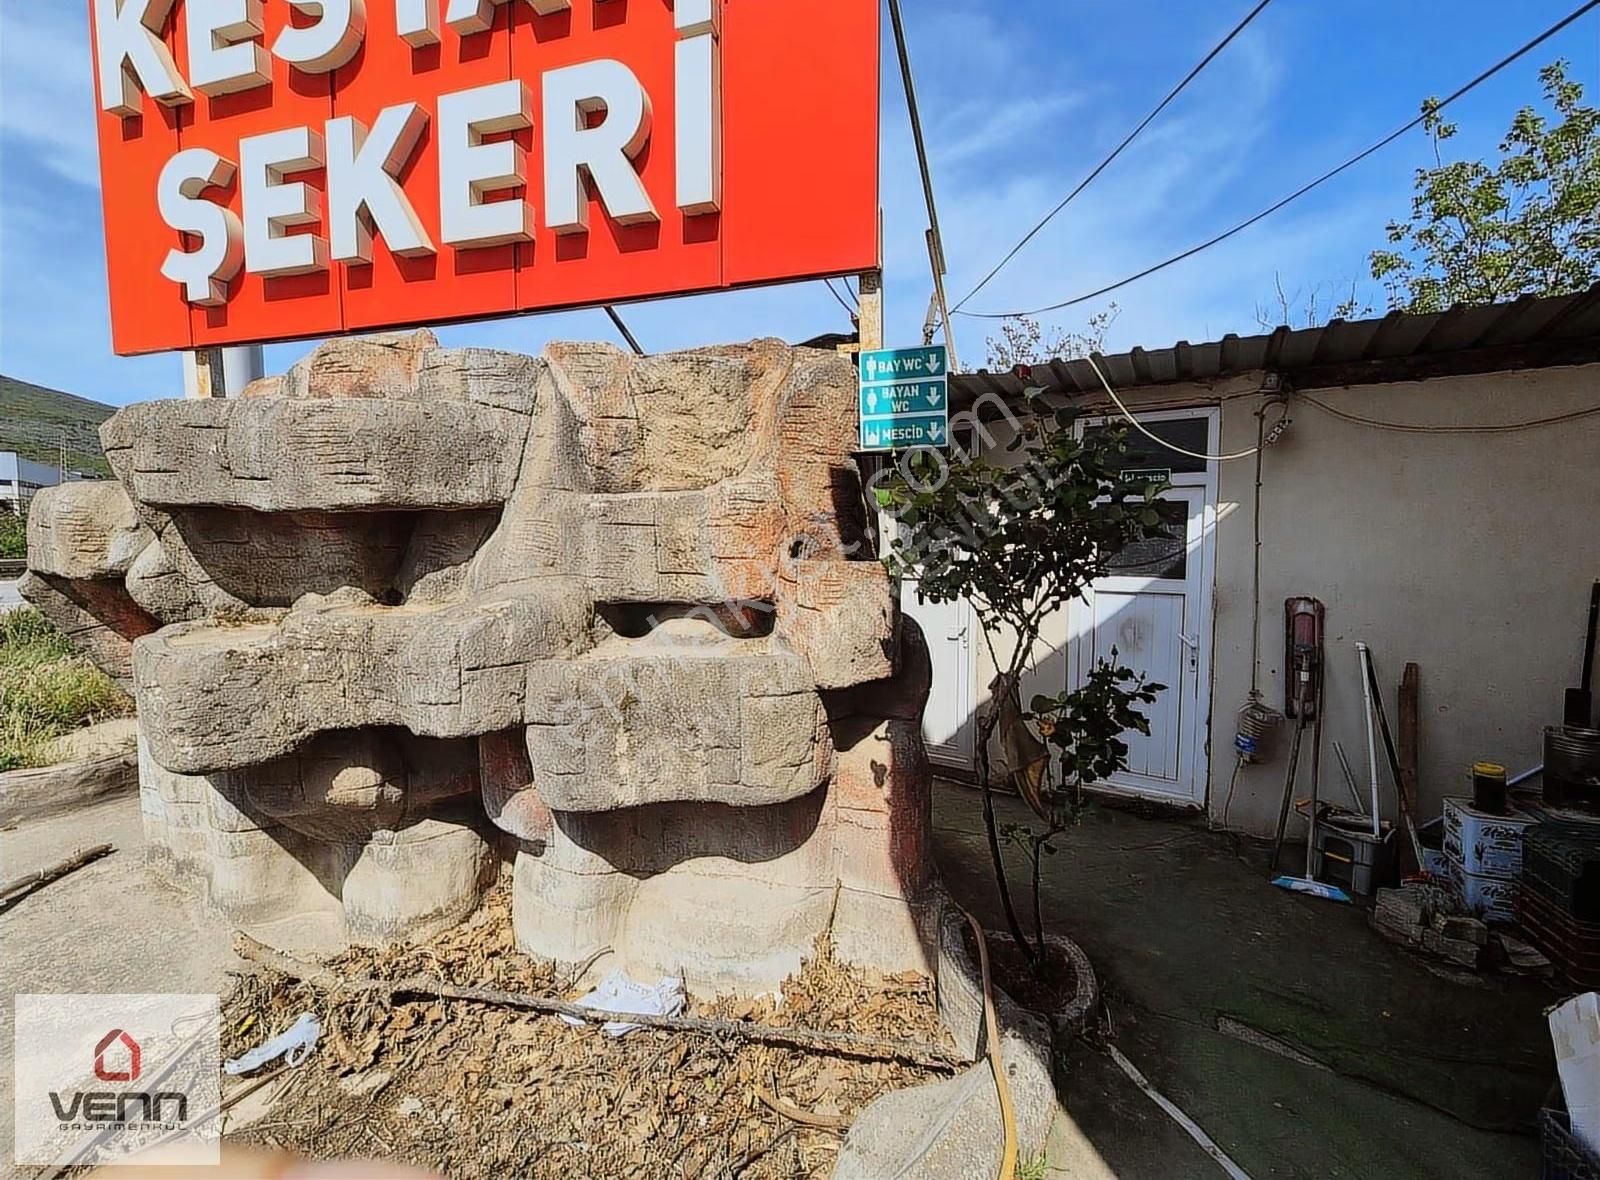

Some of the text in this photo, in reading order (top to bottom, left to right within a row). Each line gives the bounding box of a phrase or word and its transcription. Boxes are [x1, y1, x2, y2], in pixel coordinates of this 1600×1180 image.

[157, 0, 716, 304] ŞEKERİ
[878, 358, 922, 373] BAY WC
[881, 385, 919, 399] BAYAN
[891, 400, 910, 413] WC
[882, 424, 924, 440] MESCİD
